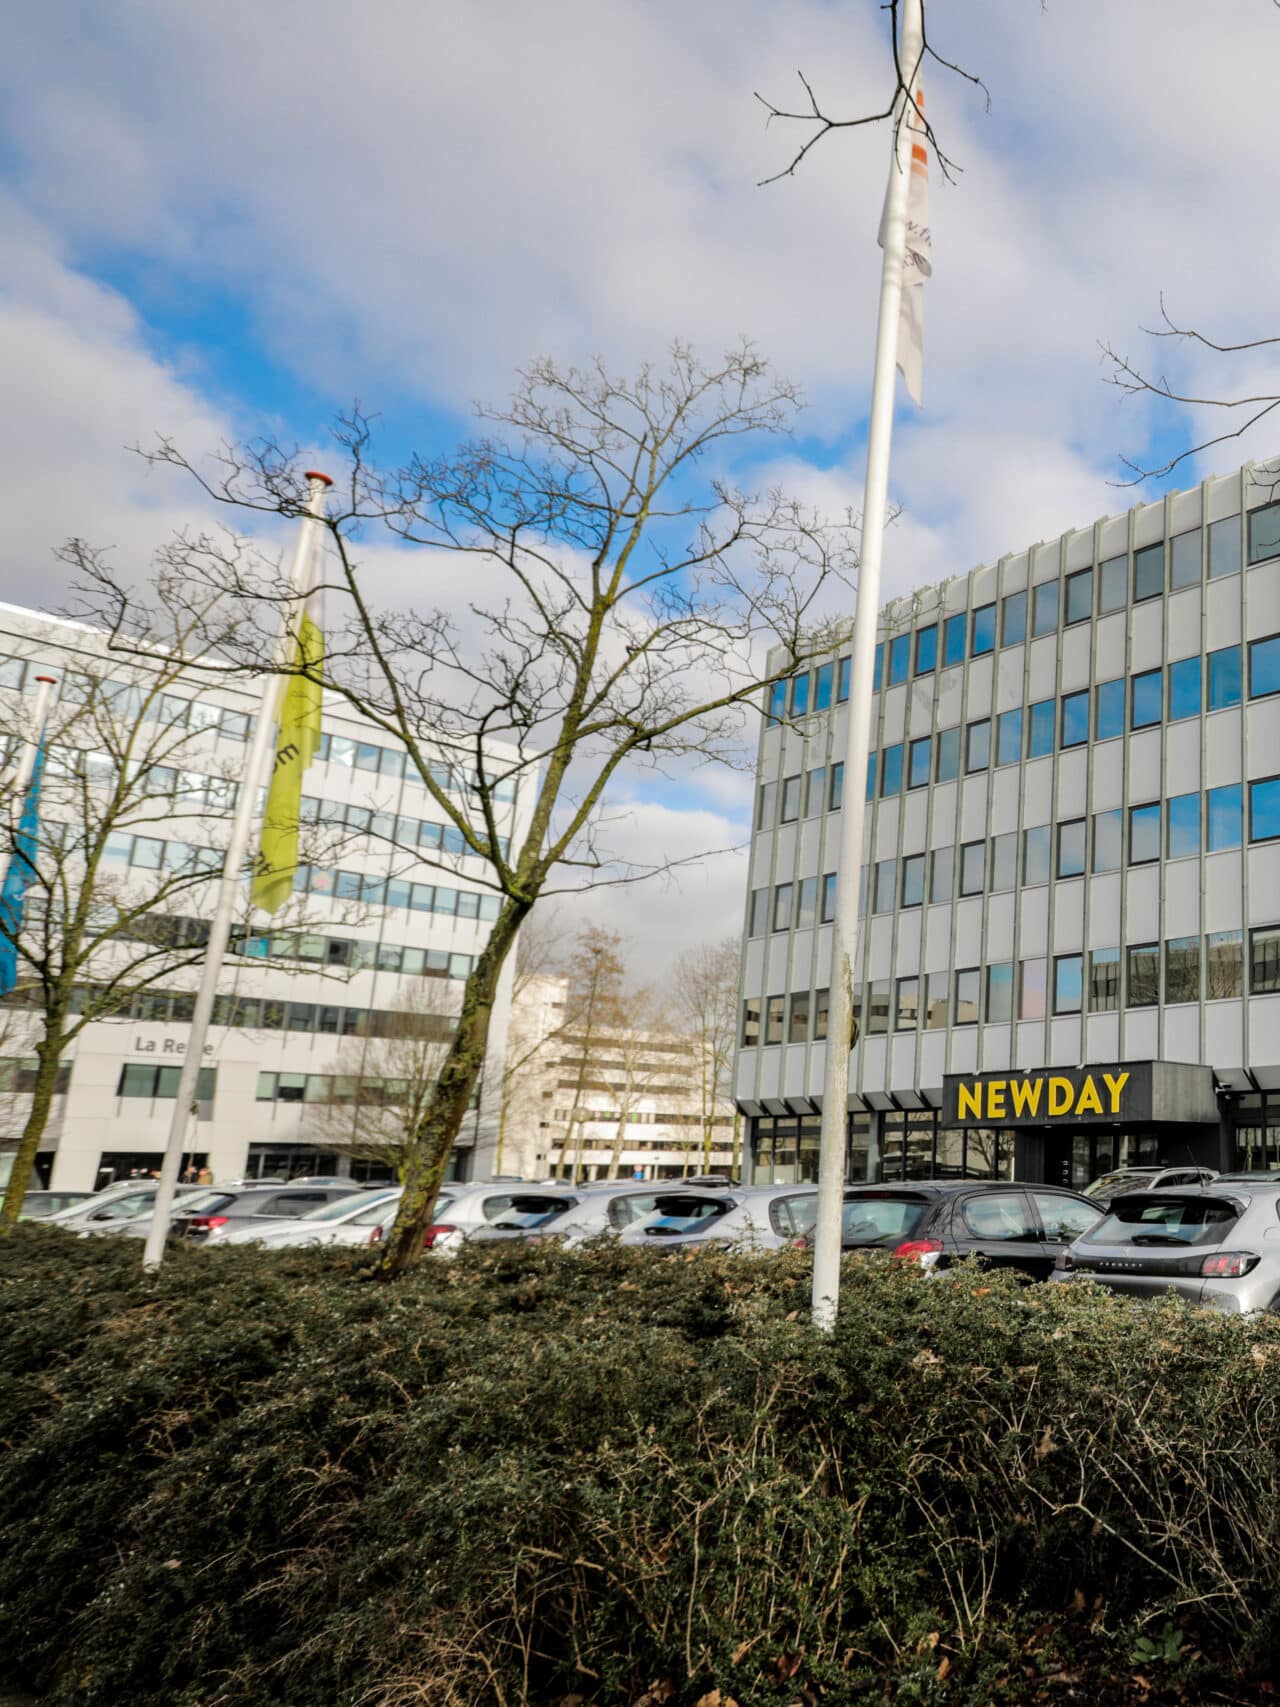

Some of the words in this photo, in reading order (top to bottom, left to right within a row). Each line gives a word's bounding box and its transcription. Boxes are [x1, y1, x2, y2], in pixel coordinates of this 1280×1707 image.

[135, 1036, 156, 1052] La
[163, 1038, 215, 1056] Ree
[958, 1072, 1131, 1120] NEWDAY
